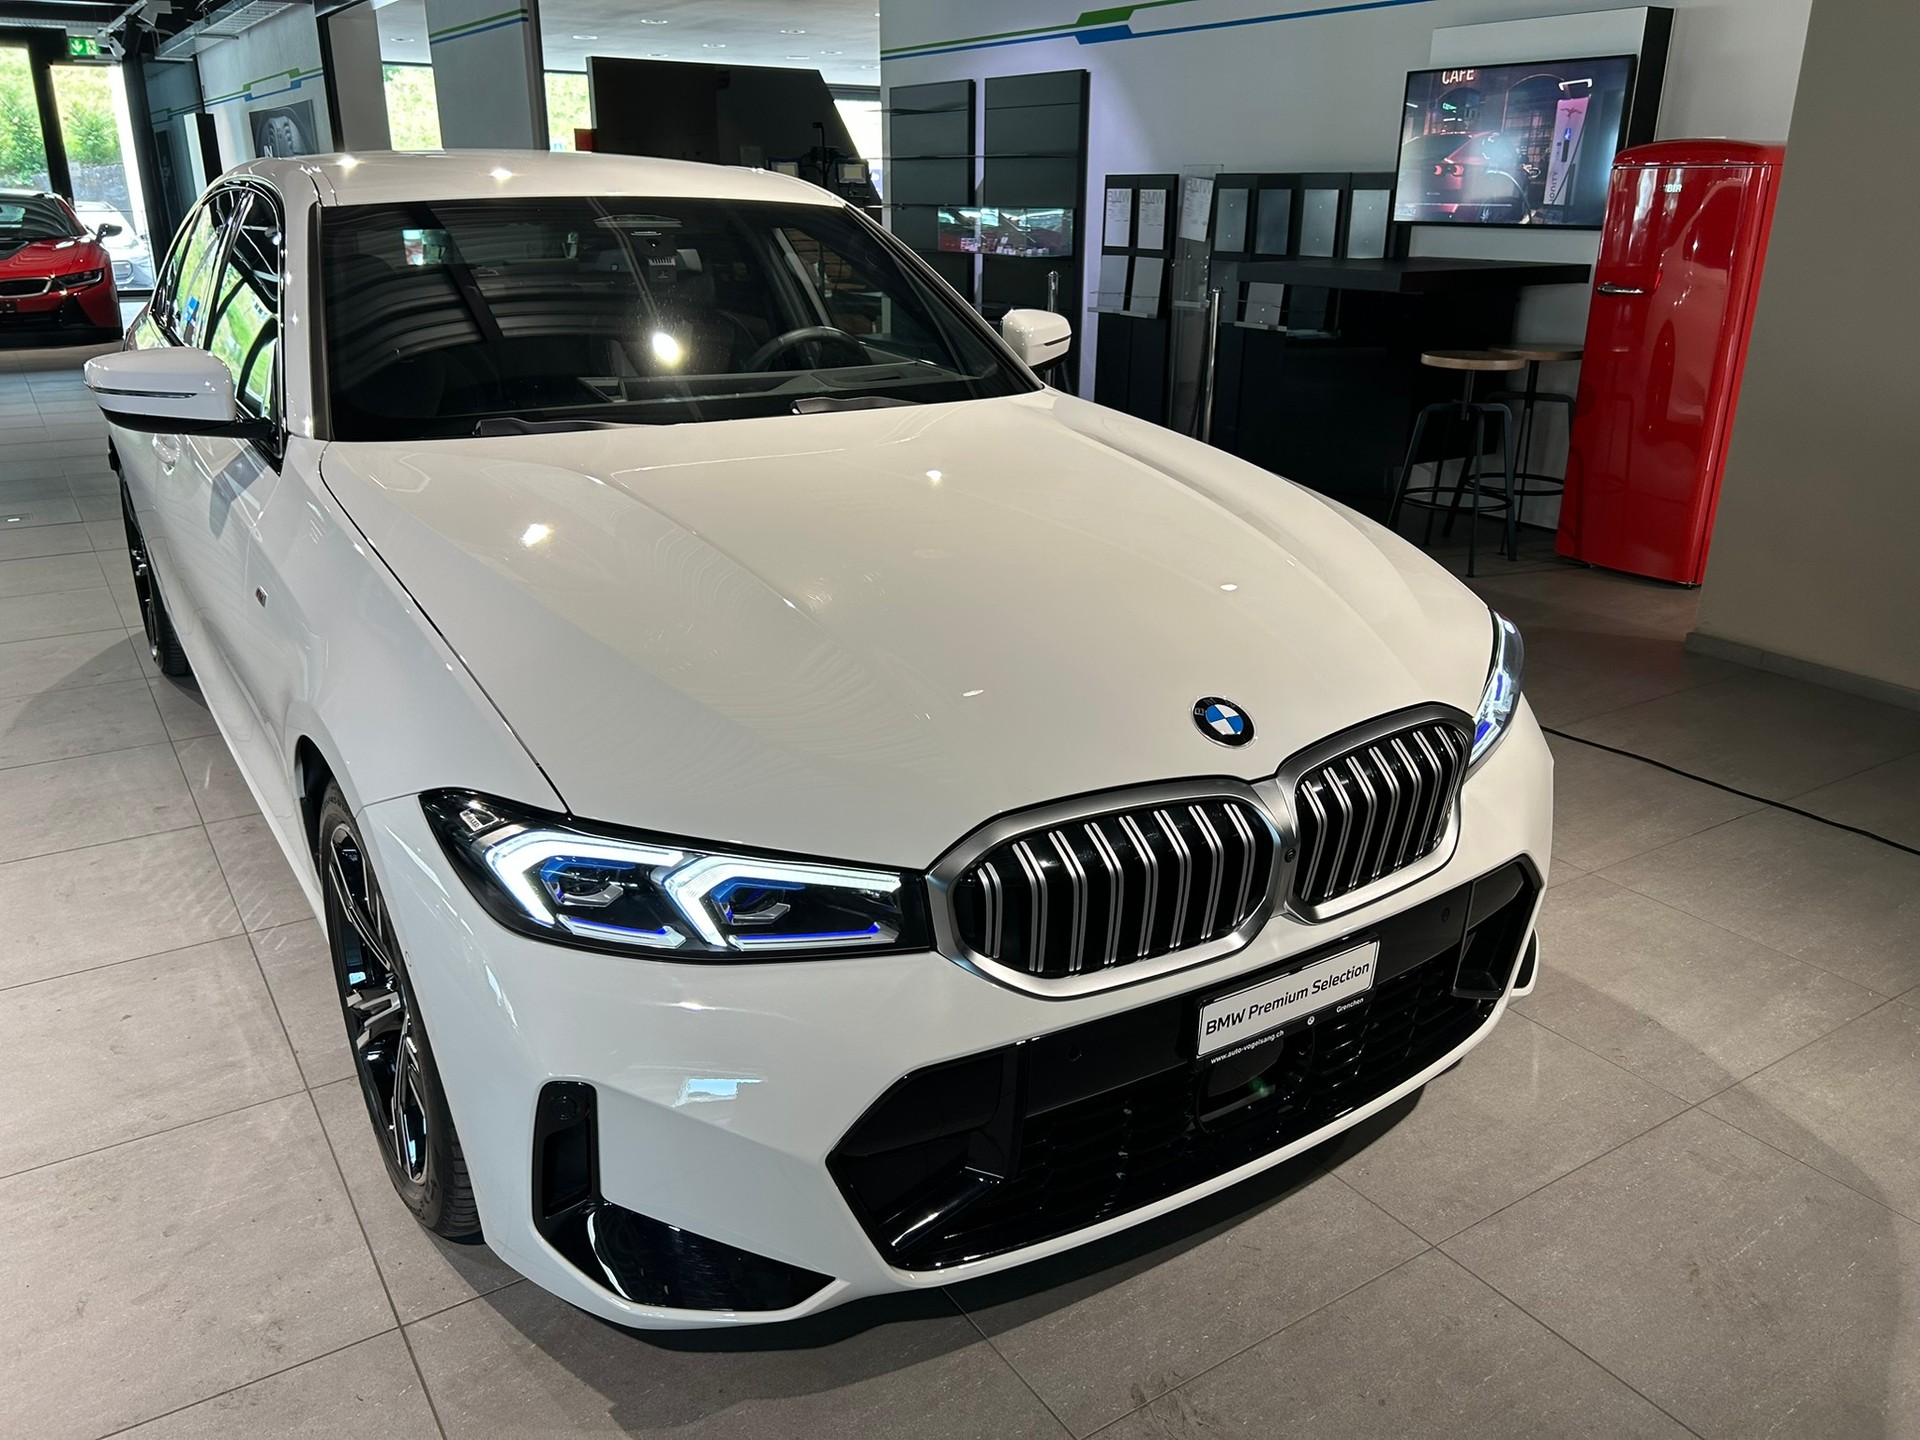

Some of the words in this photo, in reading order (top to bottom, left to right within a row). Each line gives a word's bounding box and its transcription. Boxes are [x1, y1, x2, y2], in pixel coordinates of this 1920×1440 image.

[1205, 1008, 1246, 1036] BMW
[1248, 987, 1308, 1020] Premium
[1311, 962, 1370, 995] Selection
[1336, 997, 1364, 1013] Grenchen
[1211, 1030, 1284, 1064] www.auto-vogelsang.ch
